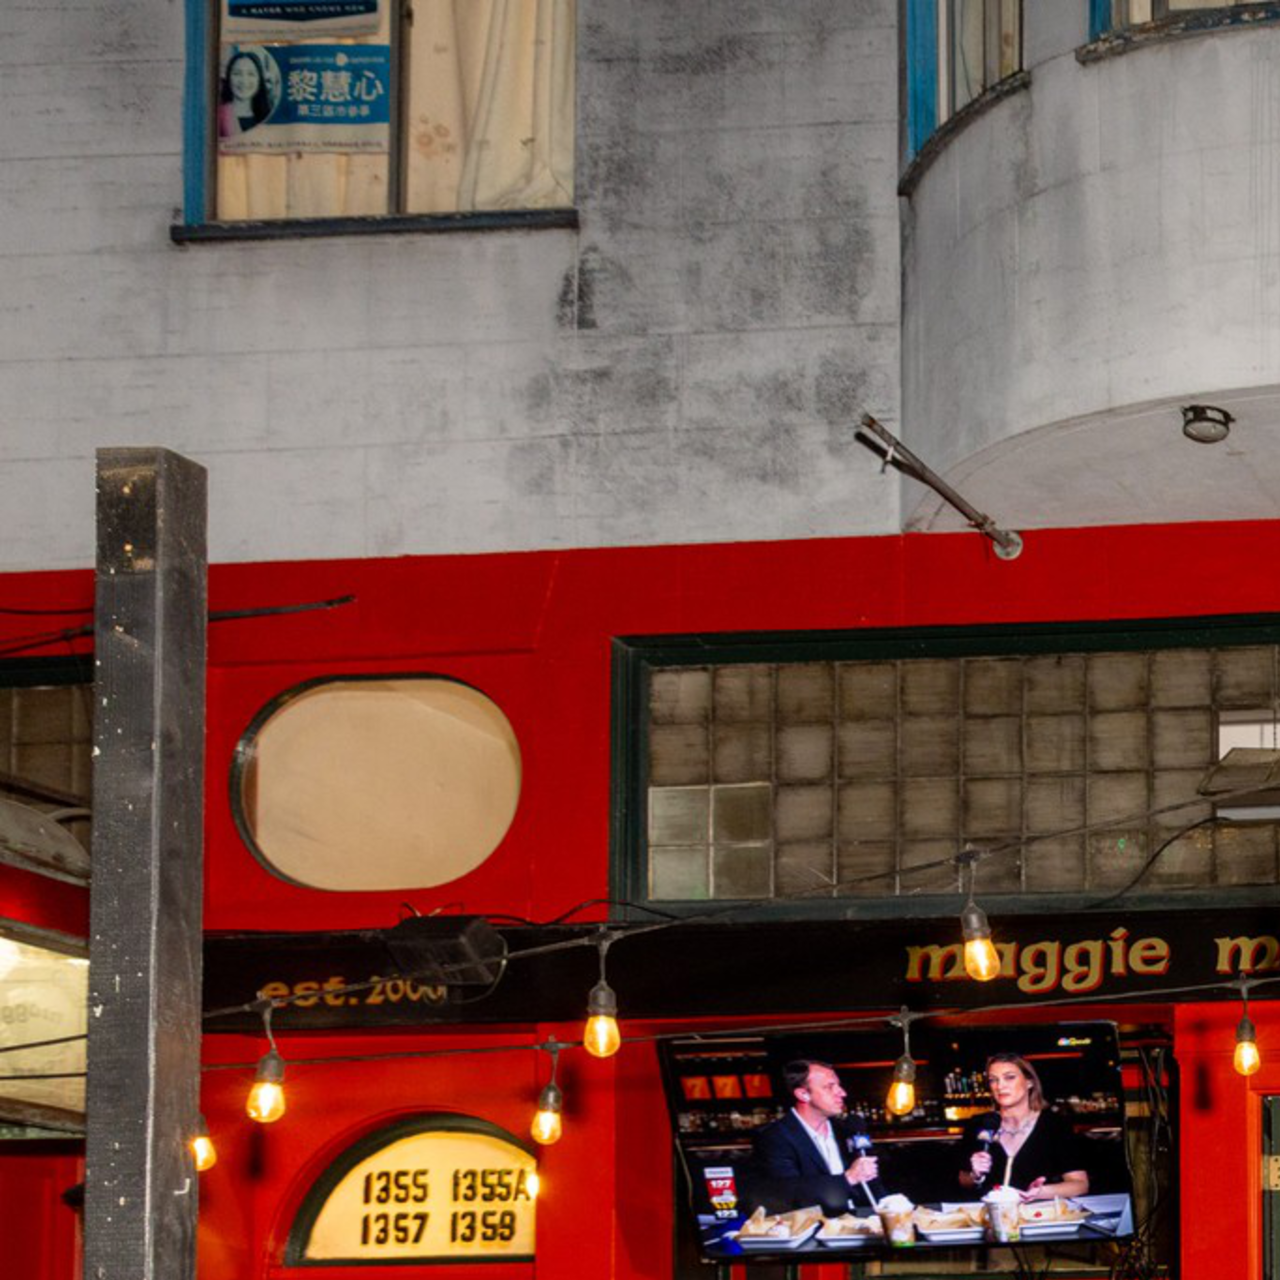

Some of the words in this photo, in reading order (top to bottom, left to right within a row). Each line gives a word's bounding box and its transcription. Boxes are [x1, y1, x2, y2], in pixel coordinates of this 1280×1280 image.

[287, 70, 384, 102] 黎慧心
[363, 1168, 429, 1204] 1355
[453, 1168, 531, 1202] 1355A
[361, 1212, 429, 1245] 1357
